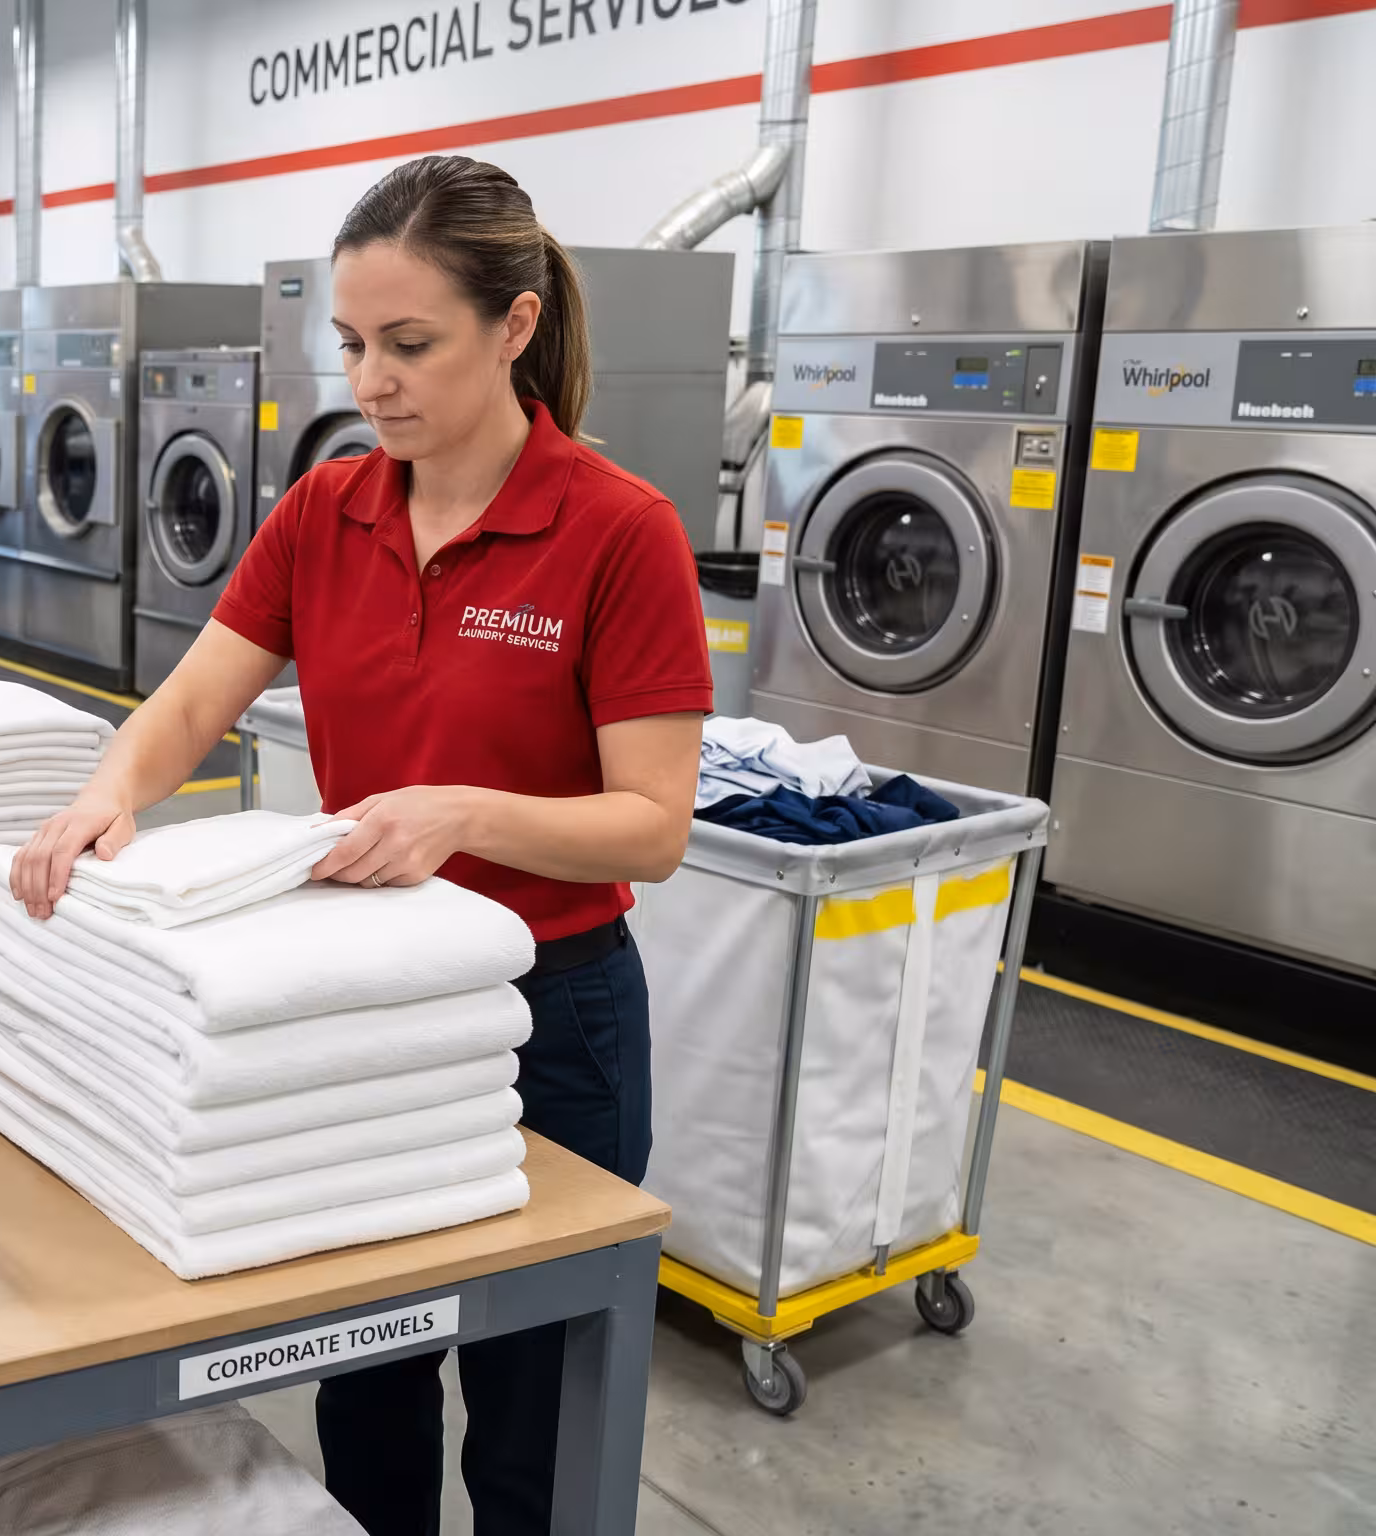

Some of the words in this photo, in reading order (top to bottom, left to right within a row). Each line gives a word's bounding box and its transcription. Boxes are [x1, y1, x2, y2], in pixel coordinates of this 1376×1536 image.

[250, 2, 494, 106] COMMERCIAL
[793, 364, 856, 385] Whirlpool
[1123, 367, 1211, 393] Whirlpool
[461, 606, 564, 640] PREMIUM
[458, 627, 506, 642] LAUNDRY
[506, 634, 560, 653] SERVICES
[207, 1333, 340, 1382] CORPORATE
[347, 1312, 434, 1348] TOWELS
